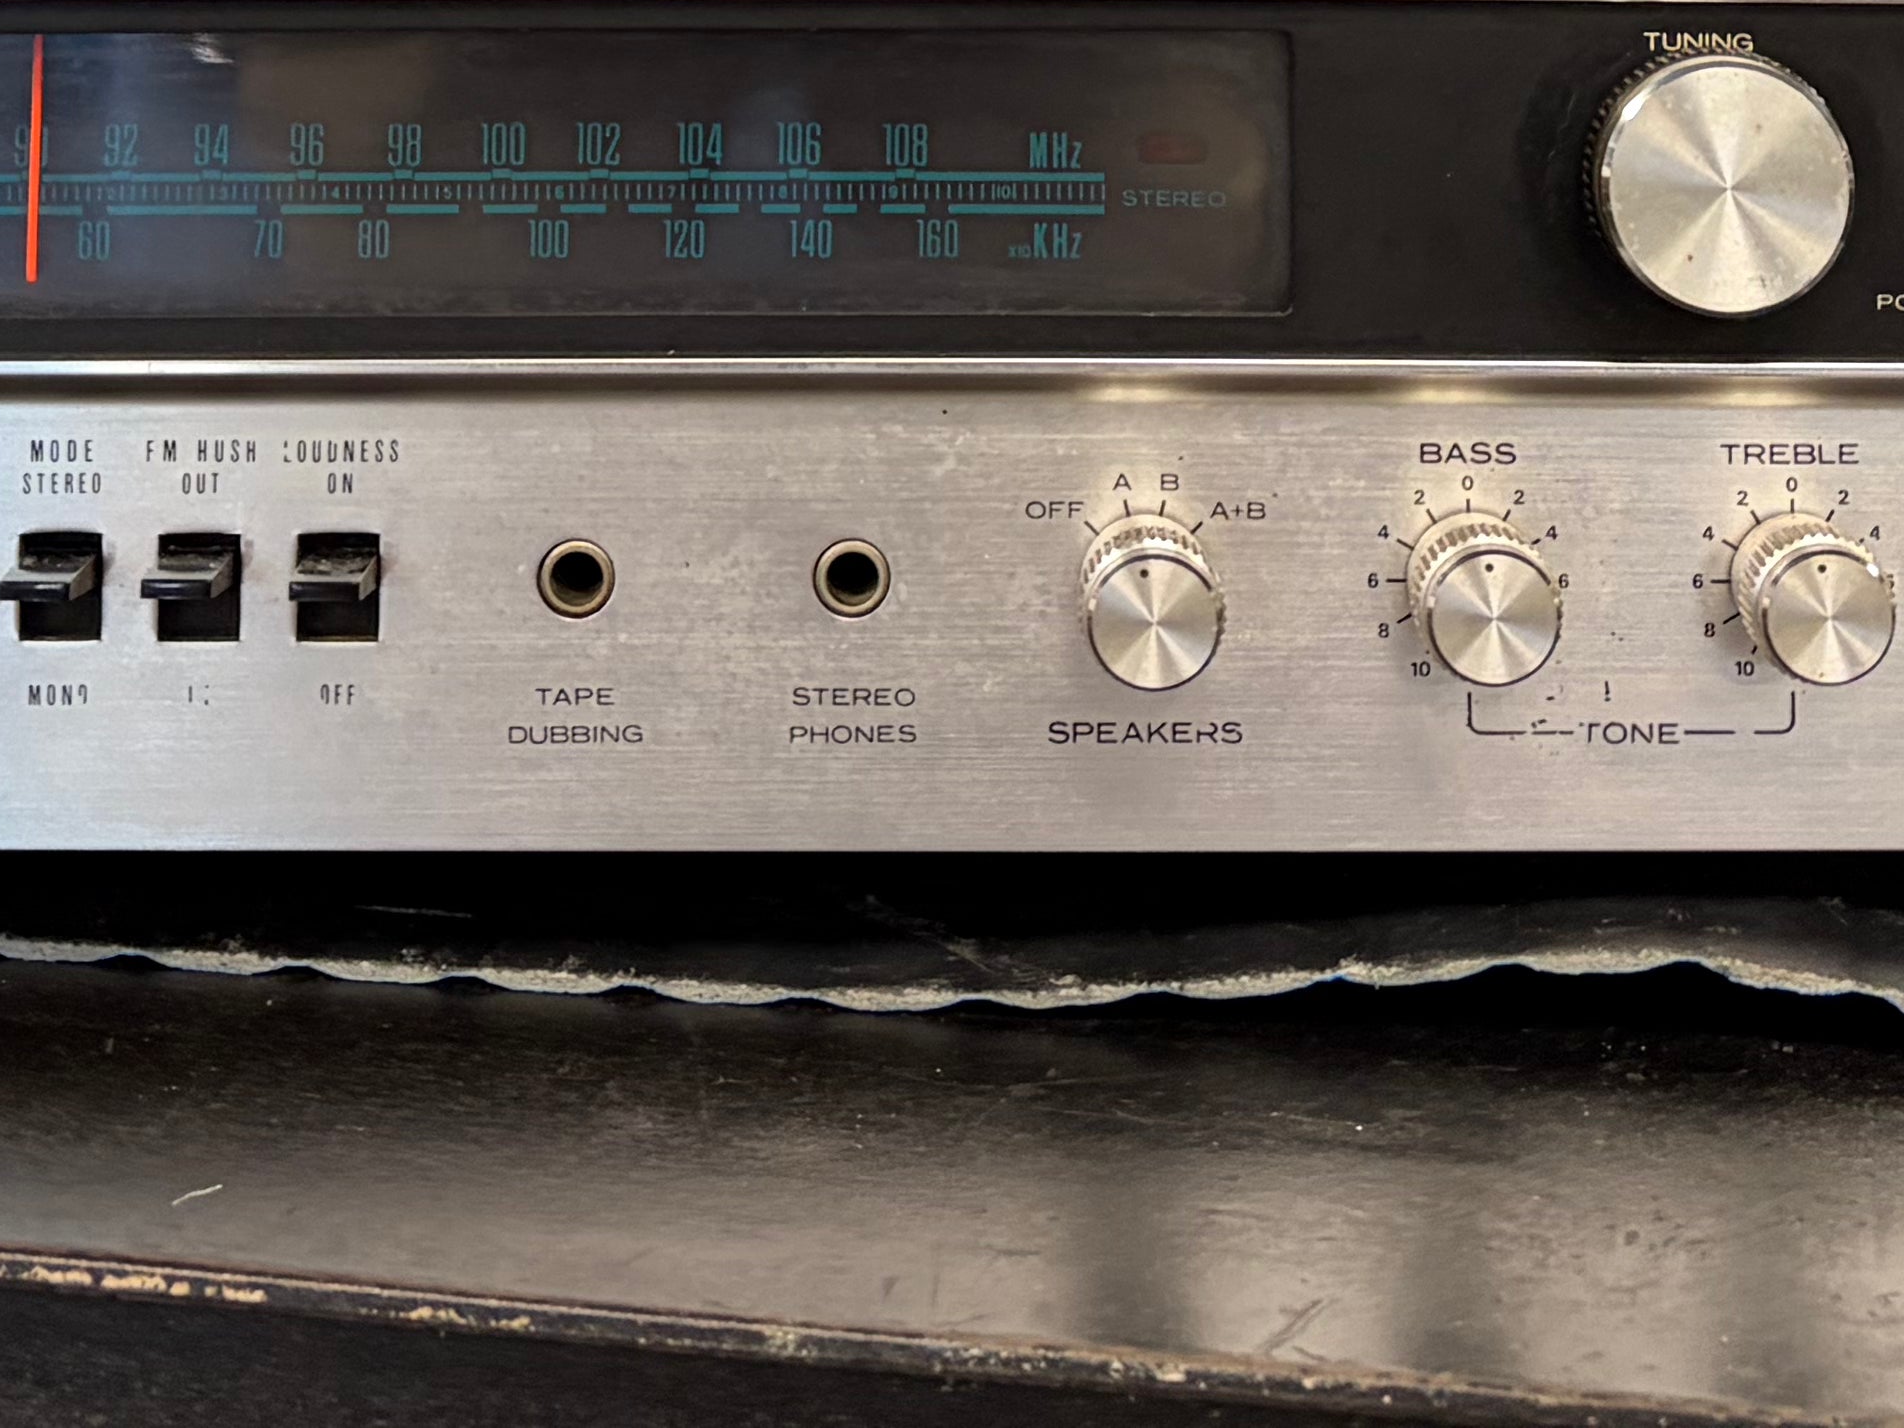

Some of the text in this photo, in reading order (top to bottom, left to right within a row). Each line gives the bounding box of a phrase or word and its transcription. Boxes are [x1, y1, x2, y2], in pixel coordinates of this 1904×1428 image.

[1644, 31, 1754, 52] TUNING
[103, 123, 138, 168] 92
[195, 122, 230, 167] 94
[290, 122, 324, 167] 96
[387, 122, 422, 168] 98
[481, 122, 526, 167] 100
[576, 122, 621, 167] 102
[677, 122, 723, 167] 104
[777, 122, 822, 167] 106
[883, 122, 928, 168] 108
[1029, 131, 1082, 170] MHz
[1122, 189, 1227, 209] STEREO
[78, 220, 111, 260] 60
[254, 220, 283, 259] 70
[358, 219, 390, 259] 80
[528, 219, 570, 258] 100
[664, 219, 705, 258] 120
[790, 219, 833, 258] 140
[916, 219, 959, 259] 160
[1034, 222, 1082, 259] KHz
[29, 439, 95, 463] MODE
[146, 439, 258, 463] FM HUSH
[1419, 442, 1517, 465] BASS
[1720, 443, 1860, 465] TREBLE
[22, 472, 103, 495] STEREO
[181, 472, 220, 495] OUT
[326, 472, 354, 495] ON
[1025, 473, 1267, 521] OFF A B A+B
[1413, 490, 1426, 505] 2
[1513, 490, 1526, 505] 2
[1736, 491, 1749, 506] 2
[1838, 490, 1850, 505] 2
[1377, 525, 1389, 540] 4
[1545, 525, 1558, 540] 4
[1702, 526, 1715, 541] 4
[1869, 525, 1880, 540] 4
[1367, 573, 1379, 588] 6
[1692, 574, 1703, 589] 6
[1378, 623, 1389, 639] 8
[1704, 622, 1716, 638] 8
[1411, 661, 1431, 677] 10
[1735, 661, 1754, 676] 10
[320, 684, 356, 706] OFF
[535, 687, 615, 706] TAPE
[791, 686, 916, 707] STEREO
[508, 724, 644, 744] DUBBING
[789, 724, 918, 744] PHONES
[1048, 721, 1244, 744] SPEAKERS
[1585, 722, 1680, 744] TONE
